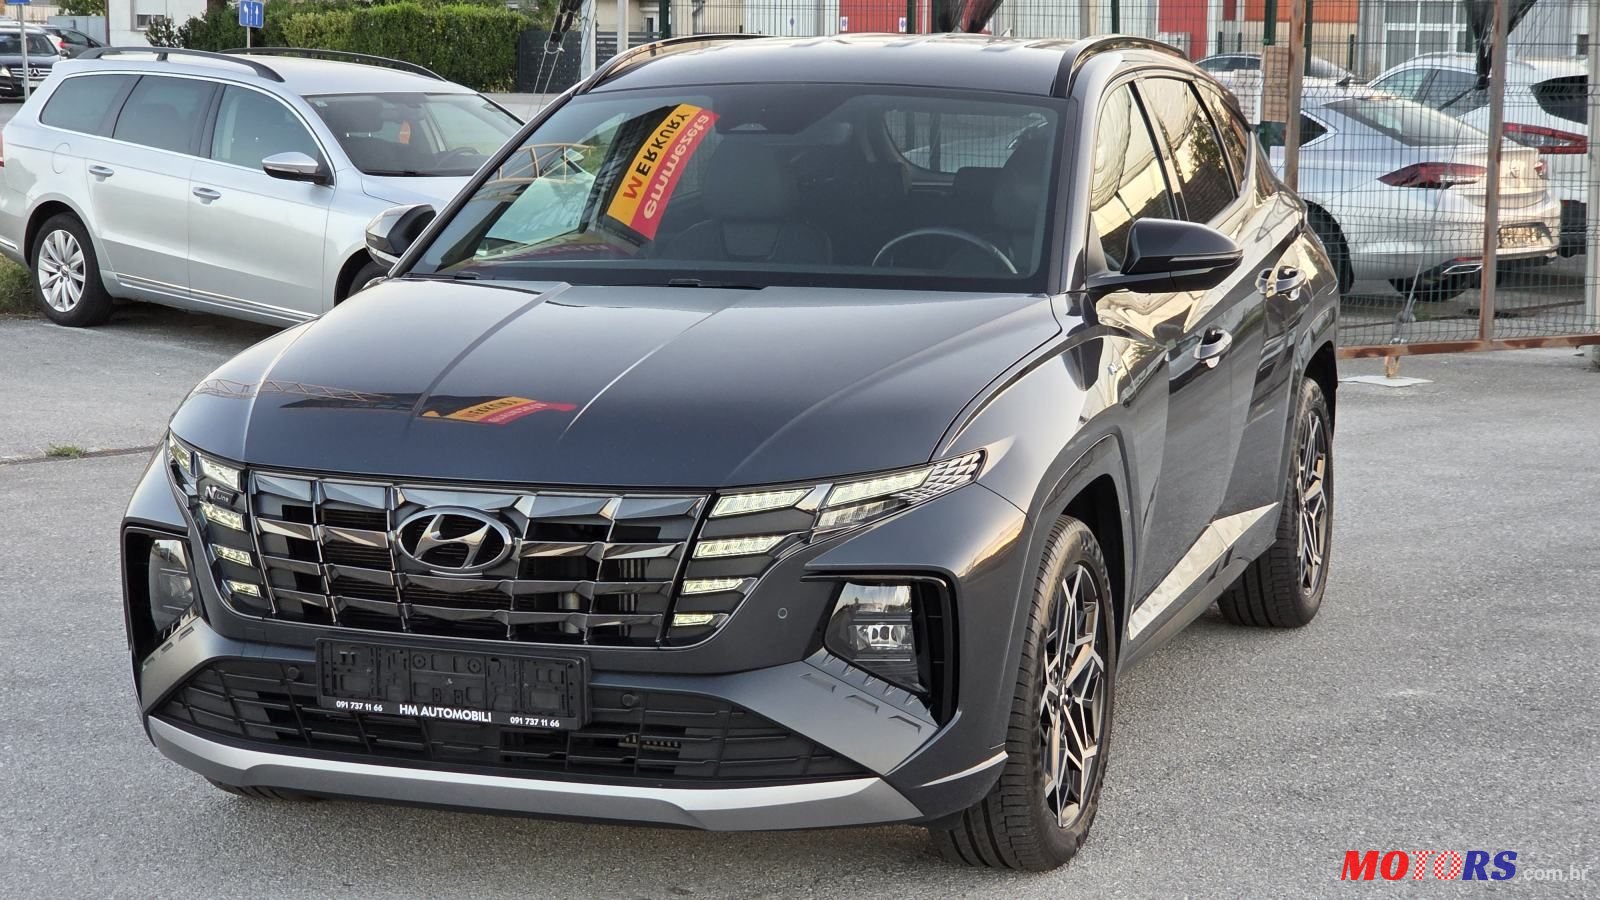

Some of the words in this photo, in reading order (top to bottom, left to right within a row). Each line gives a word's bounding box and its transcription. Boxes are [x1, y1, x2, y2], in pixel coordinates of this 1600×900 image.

[335, 700, 349, 709] 091
[350, 701, 363, 710] 737
[365, 703, 372, 711] 11
[373, 704, 383, 712] 66
[399, 704, 419, 716] HM
[420, 706, 492, 723] AUTOMOBILI
[510, 716, 523, 725] 091
[524, 717, 539, 726] 737
[541, 719, 548, 727] 11
[549, 719, 560, 728] 66
